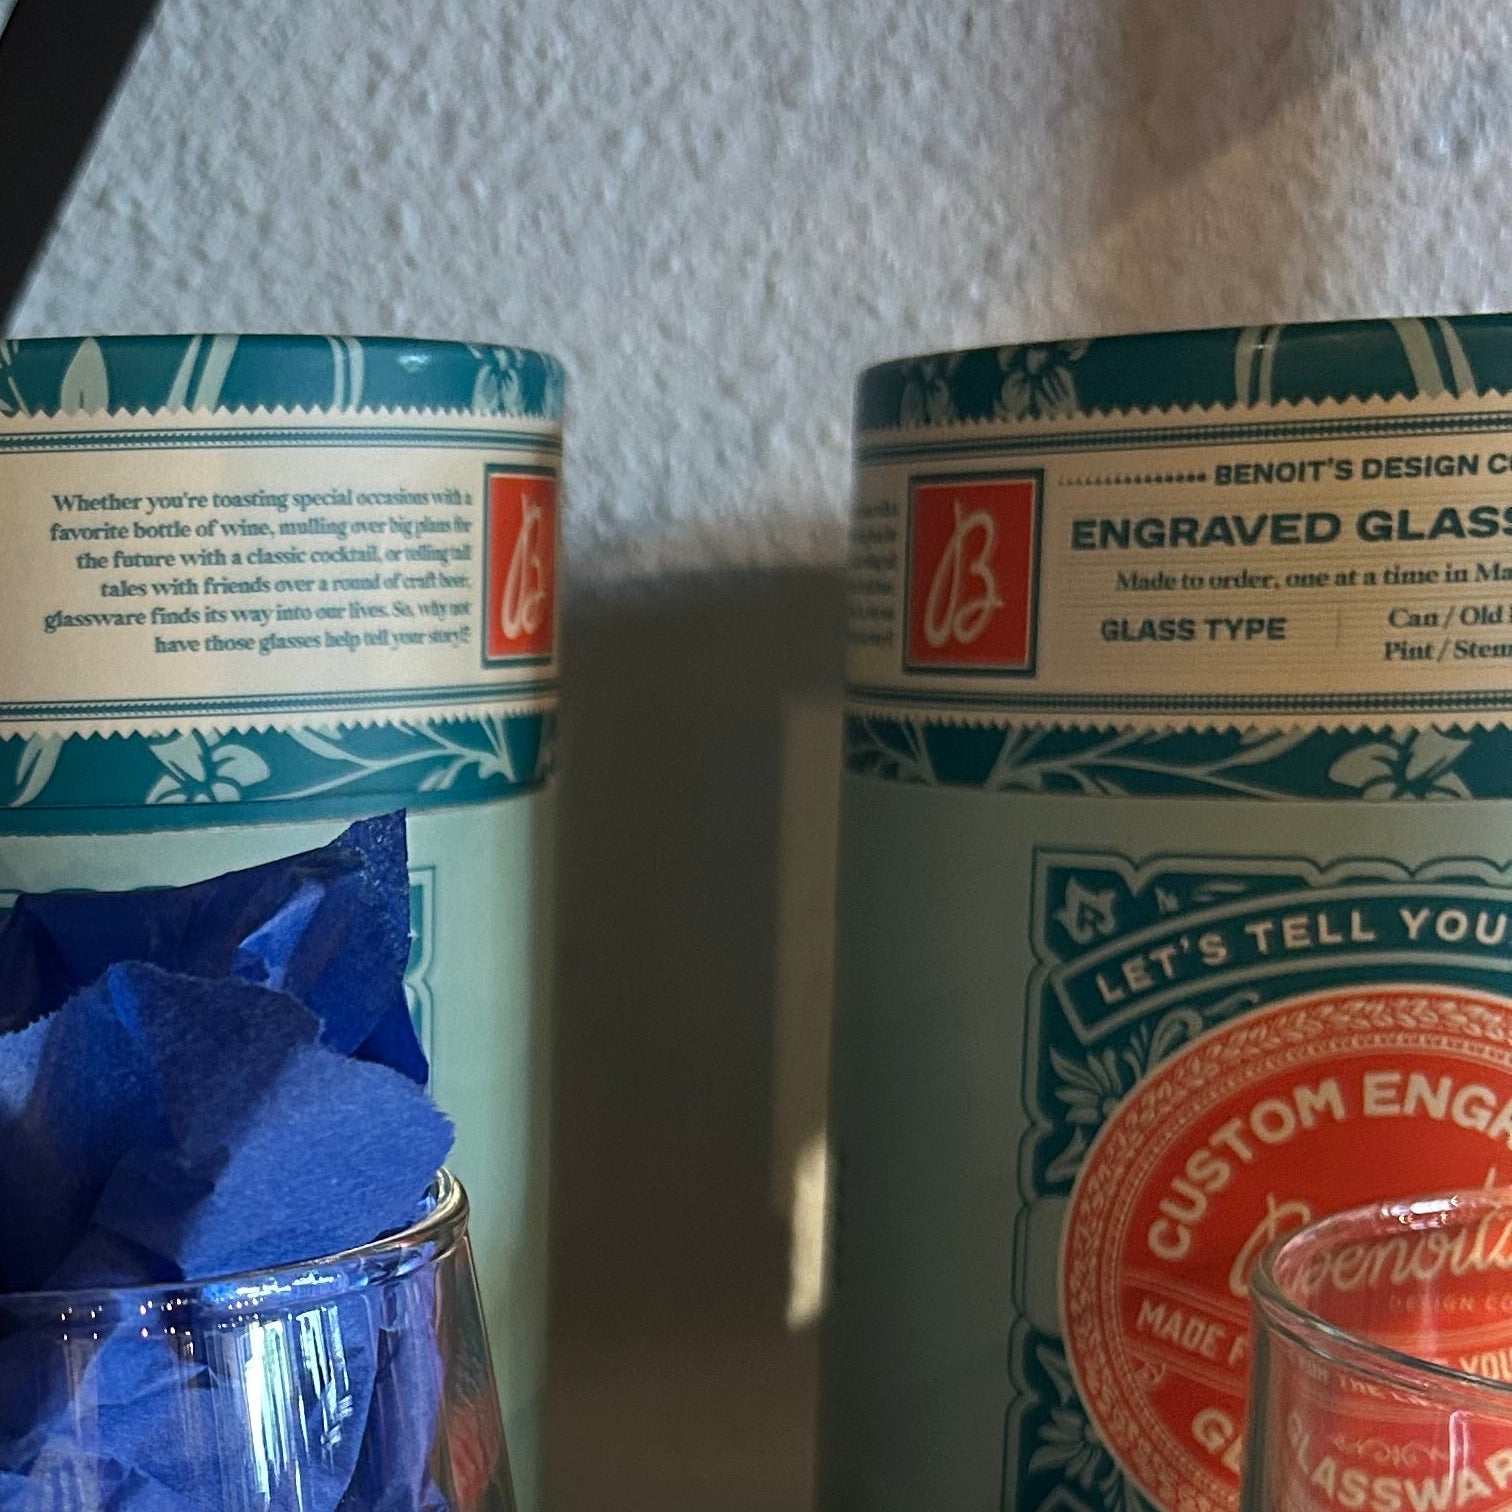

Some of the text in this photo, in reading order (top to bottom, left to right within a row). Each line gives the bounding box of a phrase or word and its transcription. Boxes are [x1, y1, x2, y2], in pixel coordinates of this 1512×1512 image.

[1214, 458, 1353, 486] BENOIT'S
[1361, 453, 1480, 480] DESIGN
[52, 493, 142, 512] Whether
[146, 492, 208, 515] you're
[212, 489, 288, 513] toasting
[292, 488, 353, 512] special
[356, 487, 429, 507] occasions
[431, 486, 462, 505] with
[49, 523, 129, 541] favorite
[134, 521, 191, 539] bottle
[196, 519, 218, 537] of
[221, 519, 275, 537] wine,
[279, 517, 348, 540] mulling
[350, 519, 387, 534] over
[389, 516, 412, 539] big
[1070, 511, 1342, 550] ENGRAVED
[76, 552, 109, 569] the
[113, 550, 176, 568] future
[180, 549, 227, 566] with
[246, 546, 306, 564] classic
[385, 549, 402, 562] or
[101, 580, 147, 598] tales
[151, 578, 199, 596] with
[203, 576, 271, 595] friends
[274, 577, 315, 593] over
[332, 574, 380, 591] round
[383, 572, 402, 590] of
[1115, 570, 1176, 592] Made
[1181, 573, 1205, 590] to
[1208, 569, 1280, 590] order,
[1284, 573, 1330, 587] one
[1333, 569, 1359, 586] at
[1362, 572, 1378, 586] a
[1382, 564, 1439, 585] time
[1444, 562, 1469, 583] in
[44, 610, 147, 634] glassware
[150, 606, 200, 626] finds
[204, 605, 228, 623] its
[231, 607, 272, 627] way
[276, 604, 313, 621] into
[315, 605, 346, 619] our
[1101, 616, 1288, 642] GLASS TYPE
[1388, 605, 1503, 629] Can Old
[154, 636, 201, 654] have
[204, 634, 256, 651] those
[259, 632, 322, 656] glasses
[324, 629, 361, 653] help
[363, 628, 388, 646] tell
[391, 631, 427, 651] your
[1384, 640, 1433, 661] Pint
[1094, 931, 1228, 1004] LET'S
[1244, 907, 1375, 955] TELL
[1146, 1077, 1348, 1261] CUSTOM
[1137, 1298, 1227, 1362] MADE
